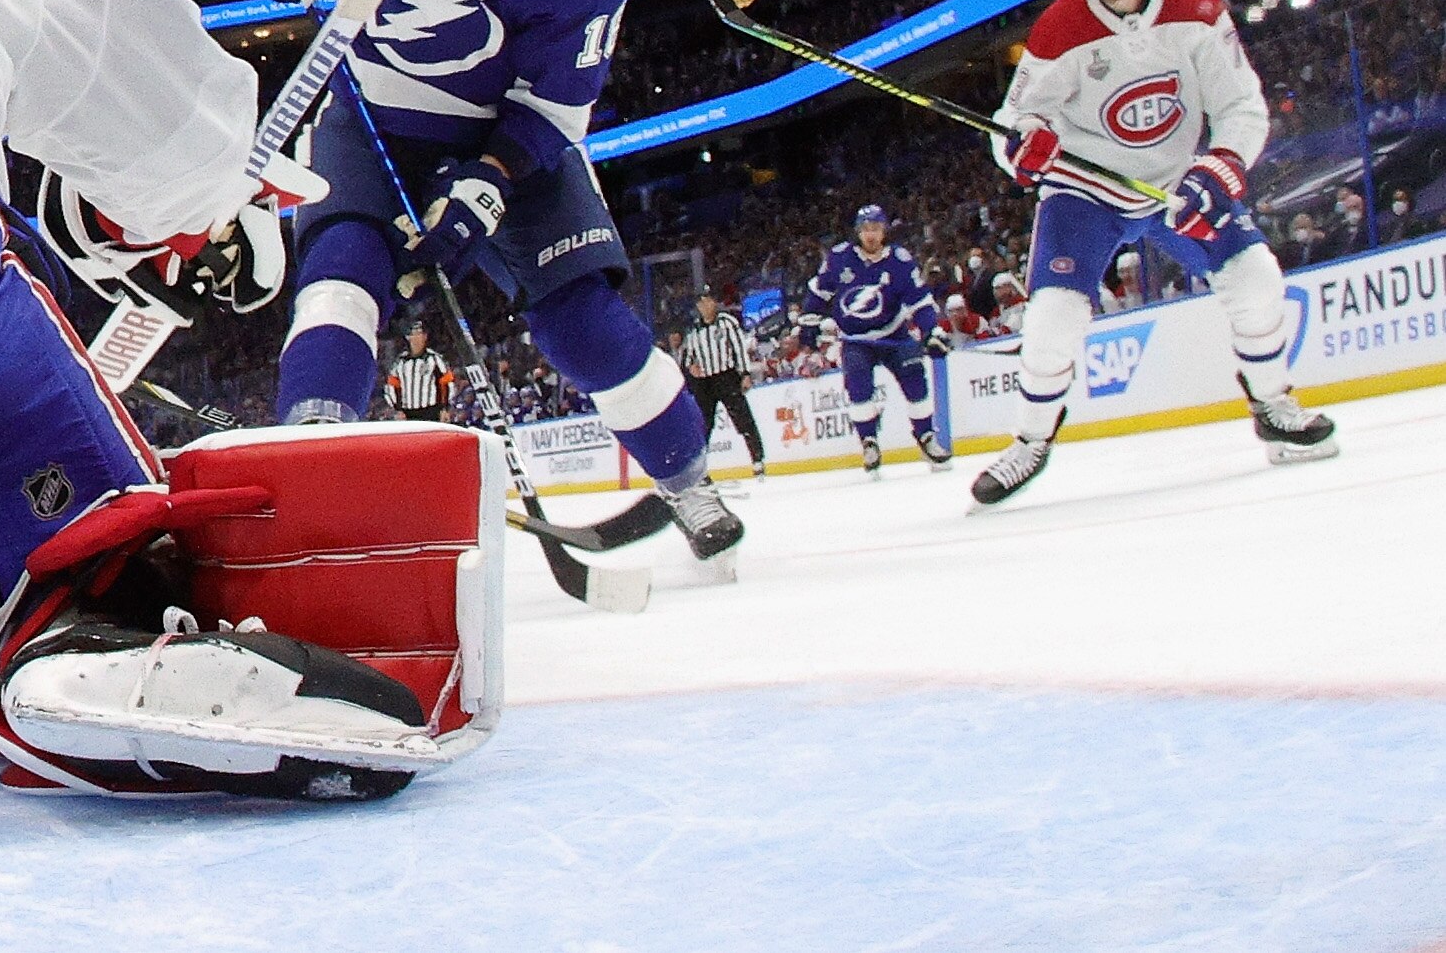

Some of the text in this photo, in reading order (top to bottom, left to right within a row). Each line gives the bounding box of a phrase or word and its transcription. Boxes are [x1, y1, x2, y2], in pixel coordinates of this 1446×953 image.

[244, 29, 354, 180] WARRIOR
[1320, 253, 1446, 324] FANDU
[95, 309, 165, 380] WARR
[1323, 308, 1446, 358] SPORTSB
[969, 371, 1020, 399] THE BE
[1085, 336, 1140, 387] SAP
[531, 427, 562, 451] NAVY
